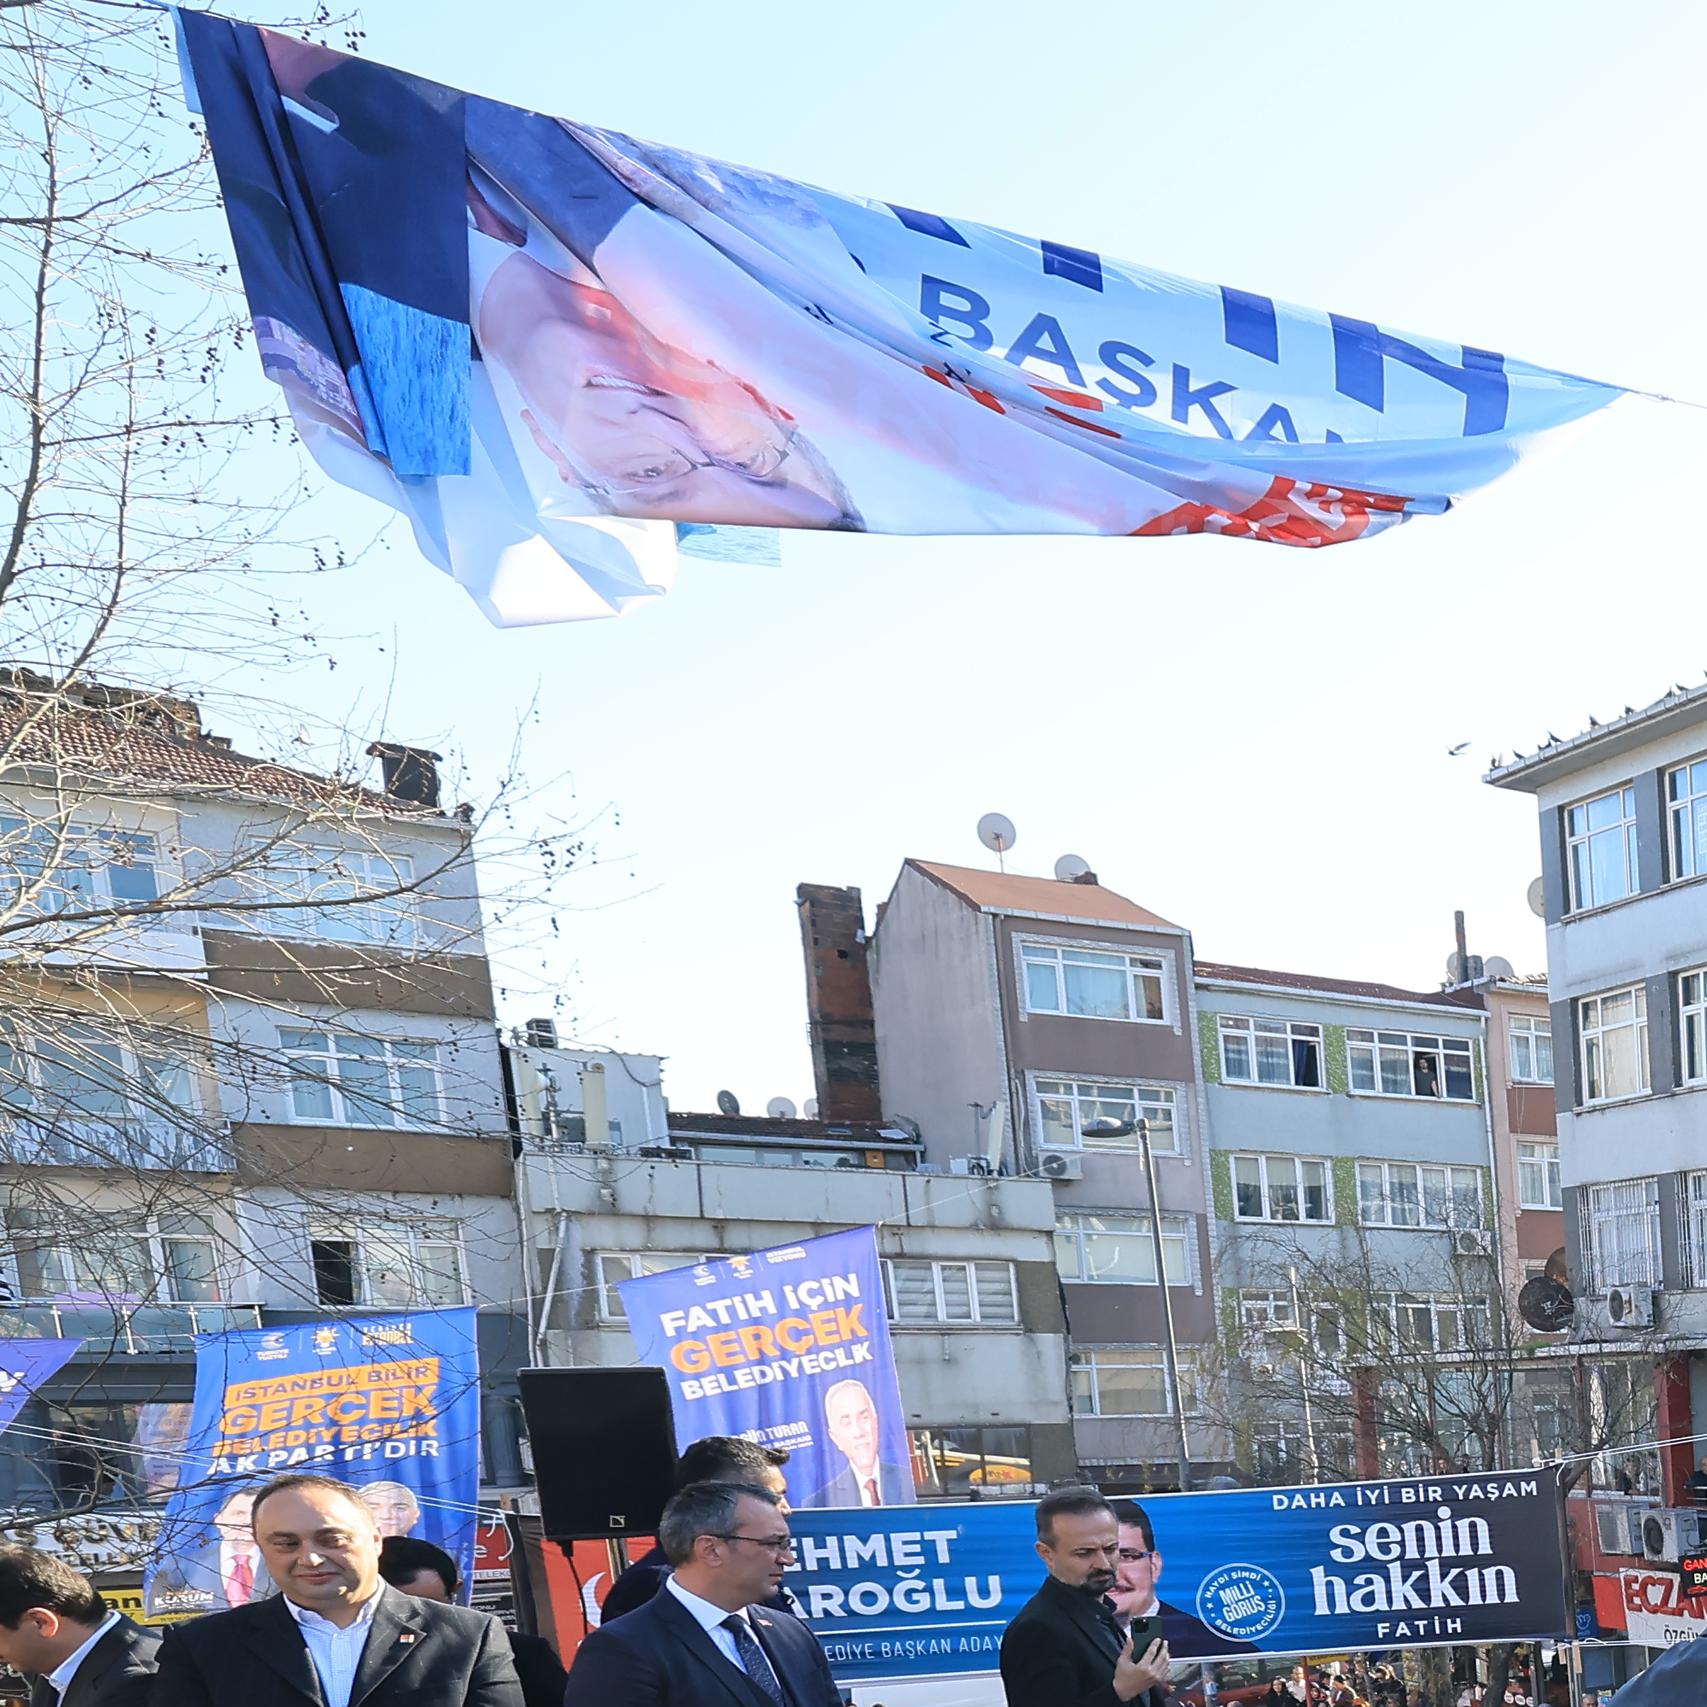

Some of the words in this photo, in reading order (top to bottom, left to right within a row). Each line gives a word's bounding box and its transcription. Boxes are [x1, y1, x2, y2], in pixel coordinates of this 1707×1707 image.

[919, 274, 1362, 444] BAŞKA
[660, 1290, 777, 1336] FATİH
[784, 1273, 860, 1310] İÇİN
[670, 1304, 869, 1374] GERÇEK
[236, 1374, 358, 1401] İSTANBUL
[367, 1366, 429, 1384] BİLİR
[218, 1386, 438, 1435] GERÇEK
[211, 1420, 439, 1457] BELEDİYECİLİK
[206, 1455, 259, 1475] AK
[1273, 1490, 1346, 1511] DAHA
[1356, 1485, 1391, 1506] İYİ
[1402, 1484, 1443, 1503] BİR
[1452, 1481, 1538, 1501] YAŞAM
[1329, 1506, 1494, 1564] senin
[1310, 1559, 1520, 1616] hakkın
[882, 1639, 951, 1660] BAŞKAN
[1377, 1618, 1463, 1639] FATİH
